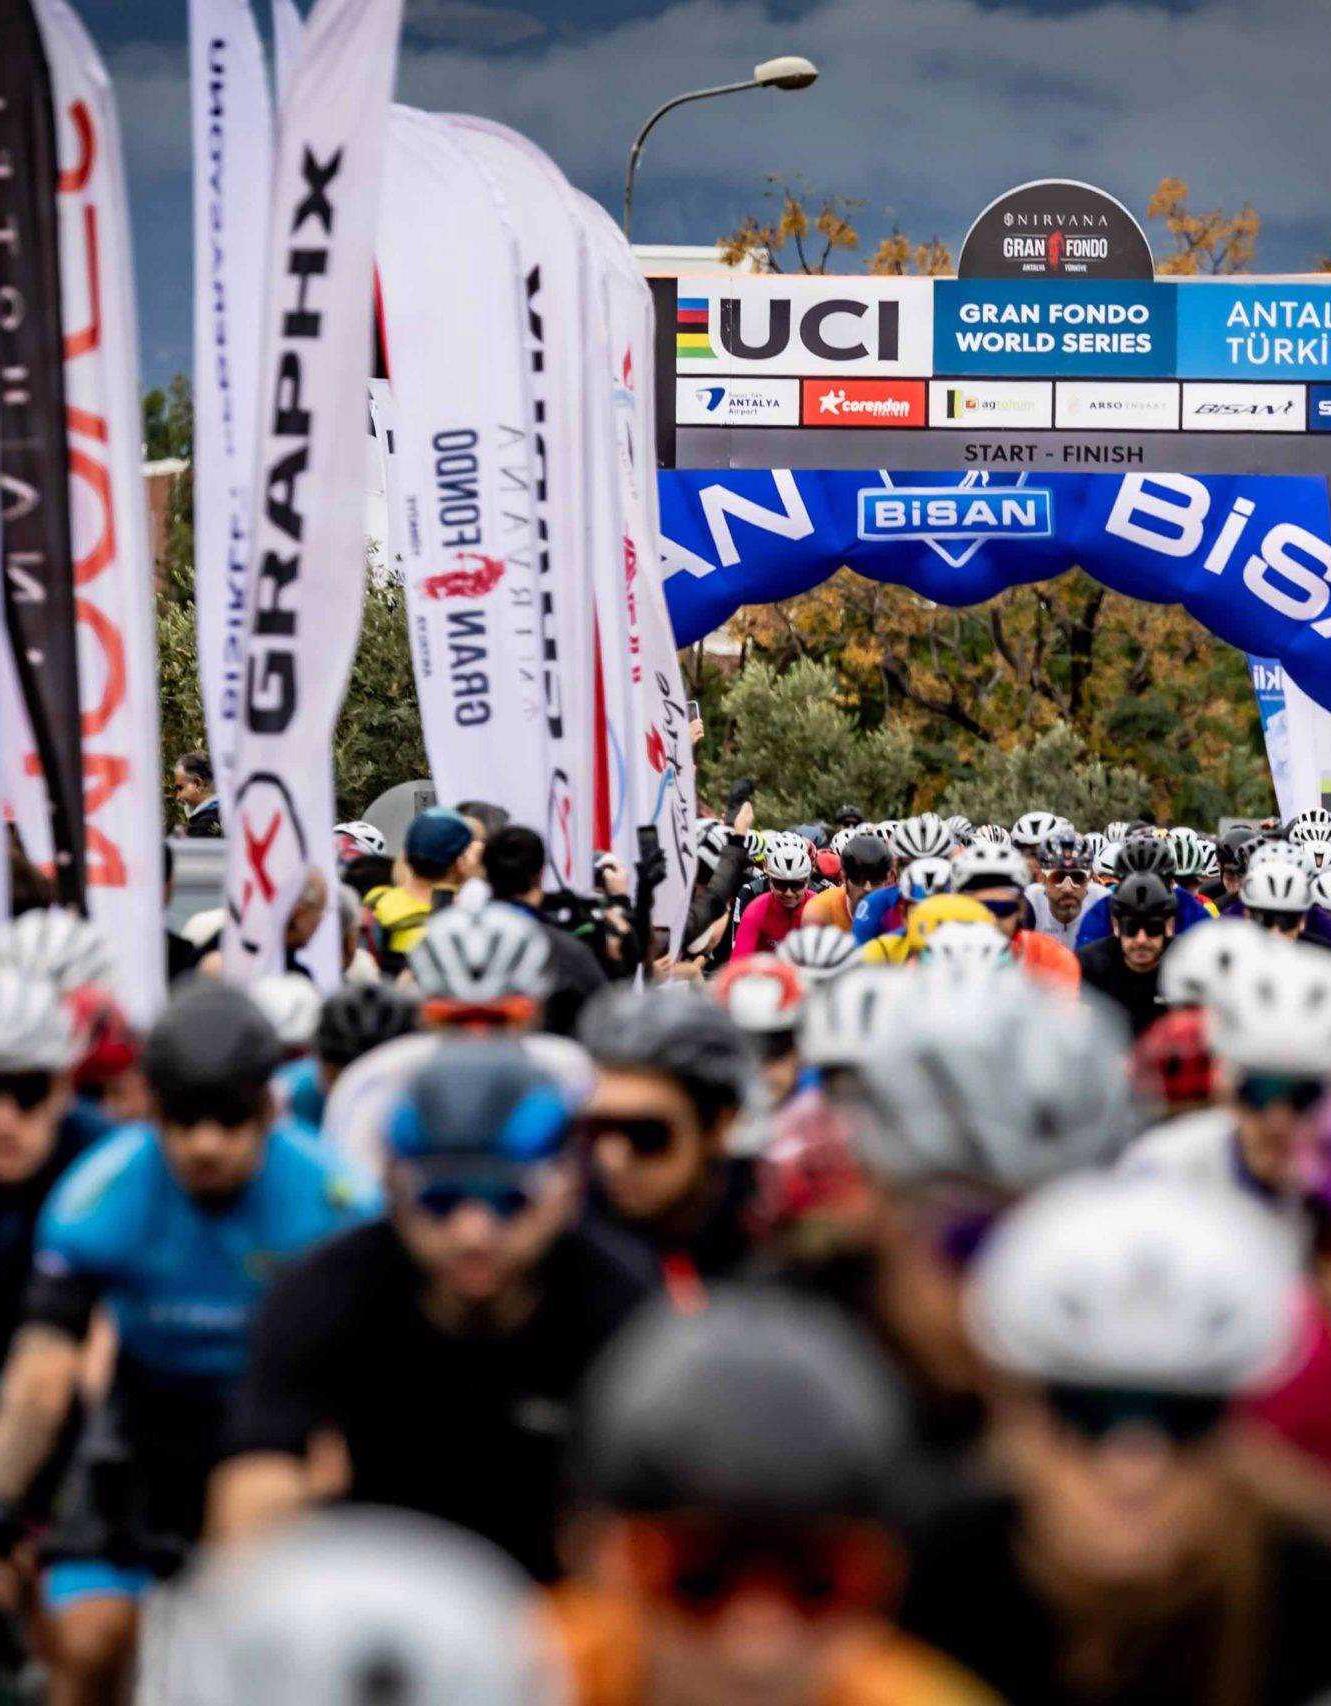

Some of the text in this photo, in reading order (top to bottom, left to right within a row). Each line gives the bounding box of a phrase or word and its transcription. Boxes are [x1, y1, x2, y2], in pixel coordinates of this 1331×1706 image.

[1017, 214, 1108, 226] NIRVANA
[1003, 238, 1108, 258] GRAN FONDO
[959, 304, 1149, 324] GRAN FONDO
[720, 299, 899, 361] UCI
[955, 332, 1151, 353] WORLD SERIES
[1226, 332, 1328, 365] TÜRKİ
[729, 400, 780, 408] ANTALYA
[965, 444, 1037, 462] START
[1063, 445, 1143, 463] FINISH
